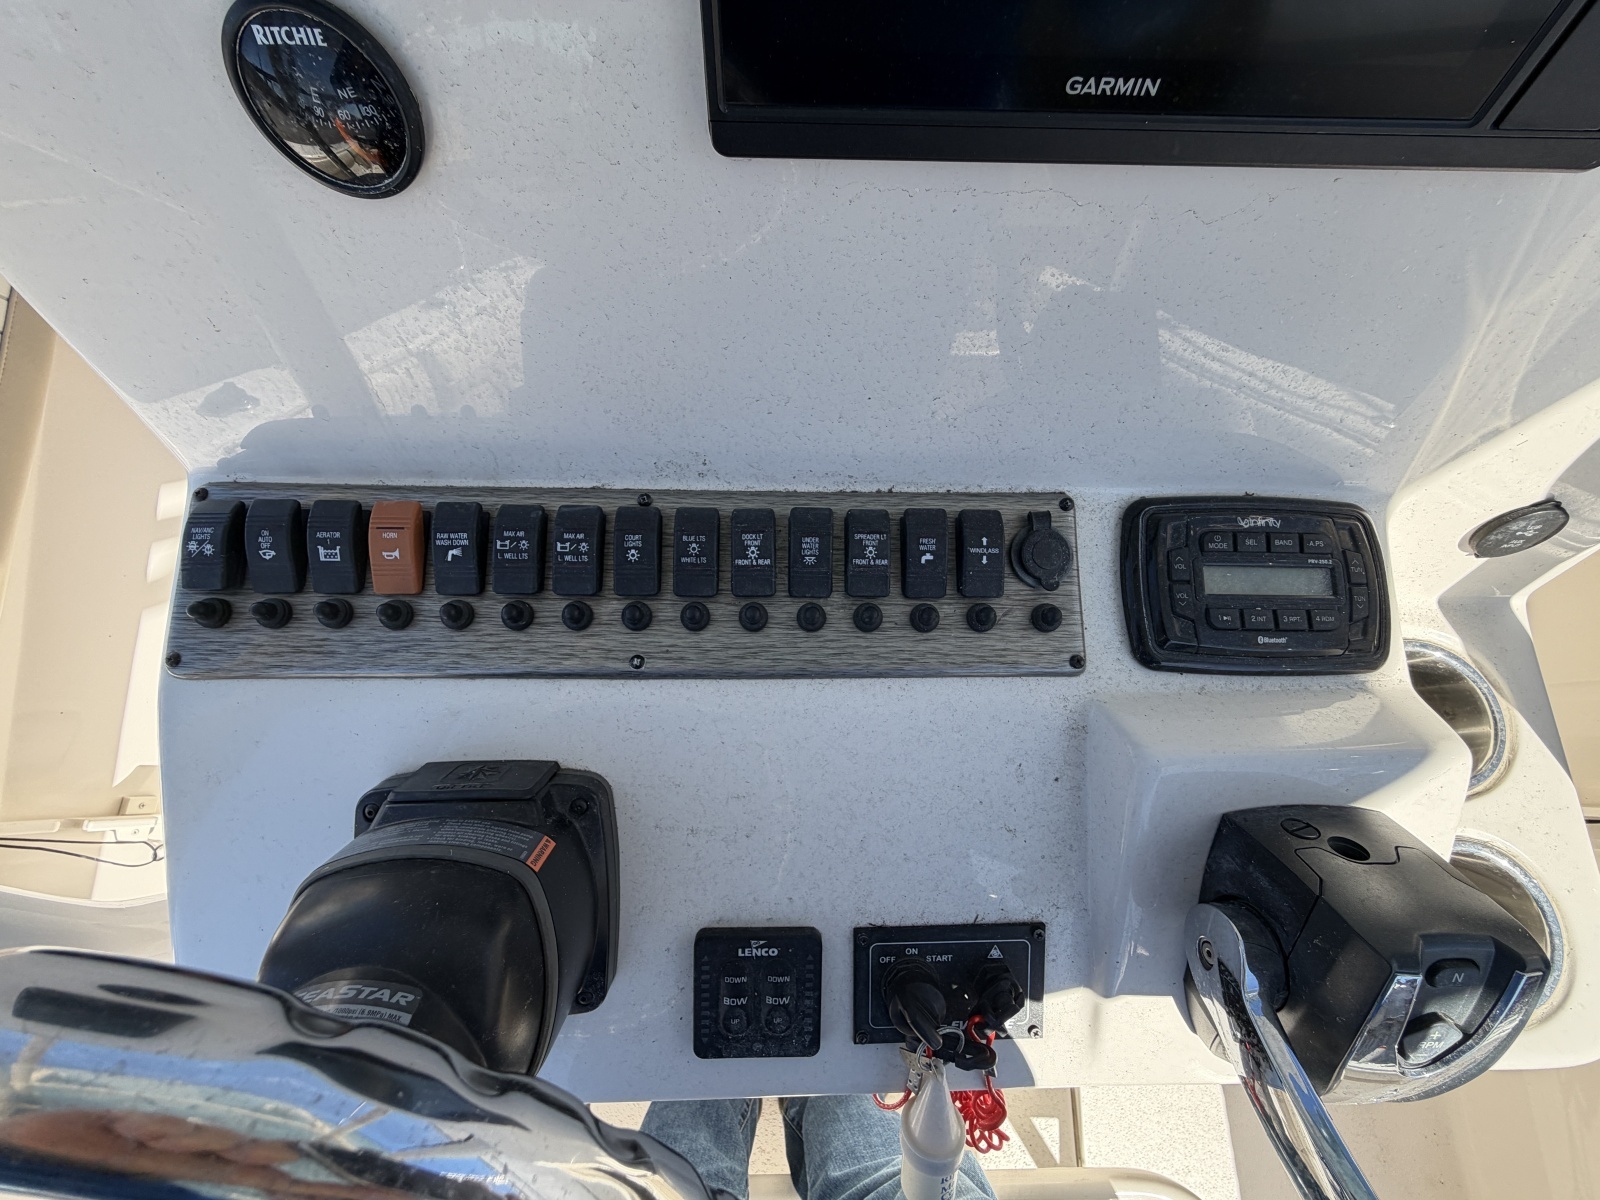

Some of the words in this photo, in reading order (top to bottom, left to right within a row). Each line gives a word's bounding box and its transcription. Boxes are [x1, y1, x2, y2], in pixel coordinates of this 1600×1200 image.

[251, 24, 327, 47] RITCHIE
[1065, 76, 1162, 97] GARMIN
[336, 86, 358, 100] NE
[313, 105, 325, 118] 90
[337, 109, 351, 121] 60
[919, 537, 936, 545] FRESH
[503, 552, 517, 560] WELL
[518, 552, 529, 560] LTS
[801, 548, 819, 556] LIGHTS
[852, 558, 869, 566] FRONT
[869, 558, 875, 566] &
[1263, 636, 1288, 644] Bluetooth
[530, 842, 550, 867] WARNING
[737, 947, 779, 957] LENCO
[905, 947, 918, 956] ON
[879, 956, 896, 964] OFF
[926, 954, 953, 963] START
[724, 976, 748, 984] DOWN
[1451, 972, 1465, 983] N
[723, 996, 748, 1006] BOW
[765, 995, 790, 1005] BOW
[388, 1012, 402, 1021] MAX
[1417, 1041, 1445, 1049] RPM
